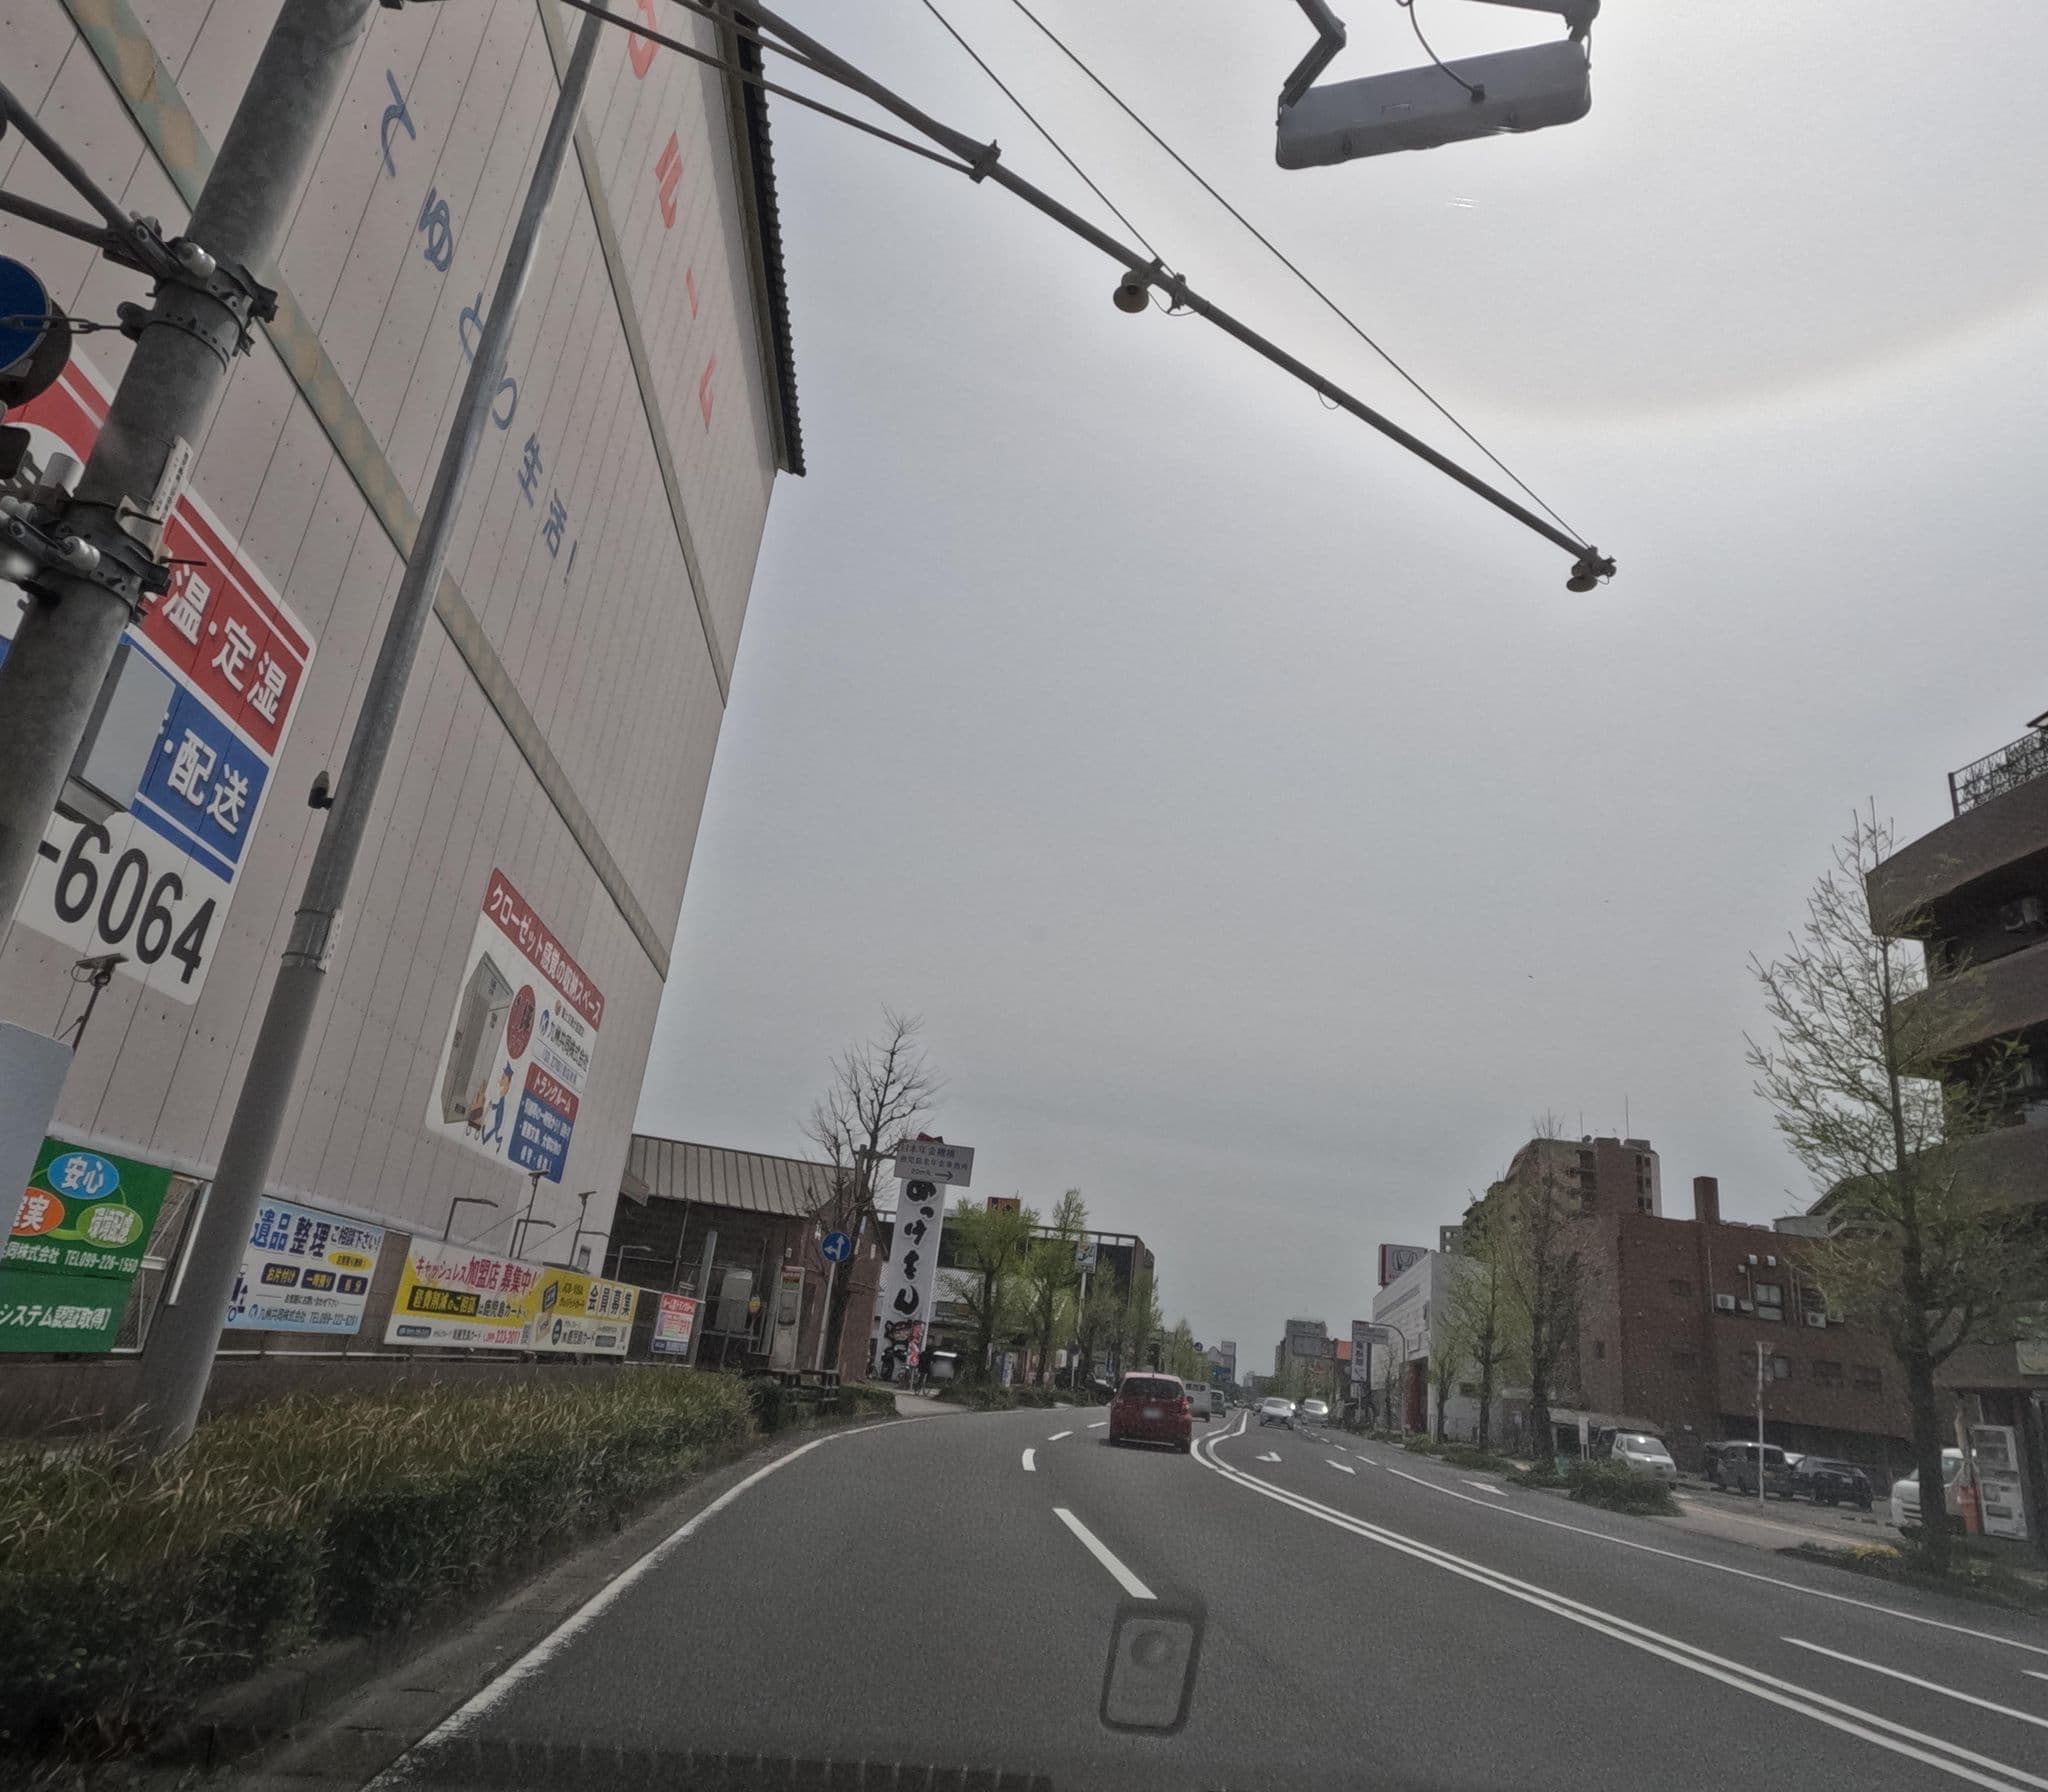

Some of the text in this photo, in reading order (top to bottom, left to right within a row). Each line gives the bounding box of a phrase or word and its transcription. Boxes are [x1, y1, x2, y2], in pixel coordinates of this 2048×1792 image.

[532, 1071, 572, 1115] トランクルーム
[61, 1156, 104, 1194] 安心
[5, 1241, 60, 1264] 同株式会社
[500, 1263, 537, 1296] 募集中!
